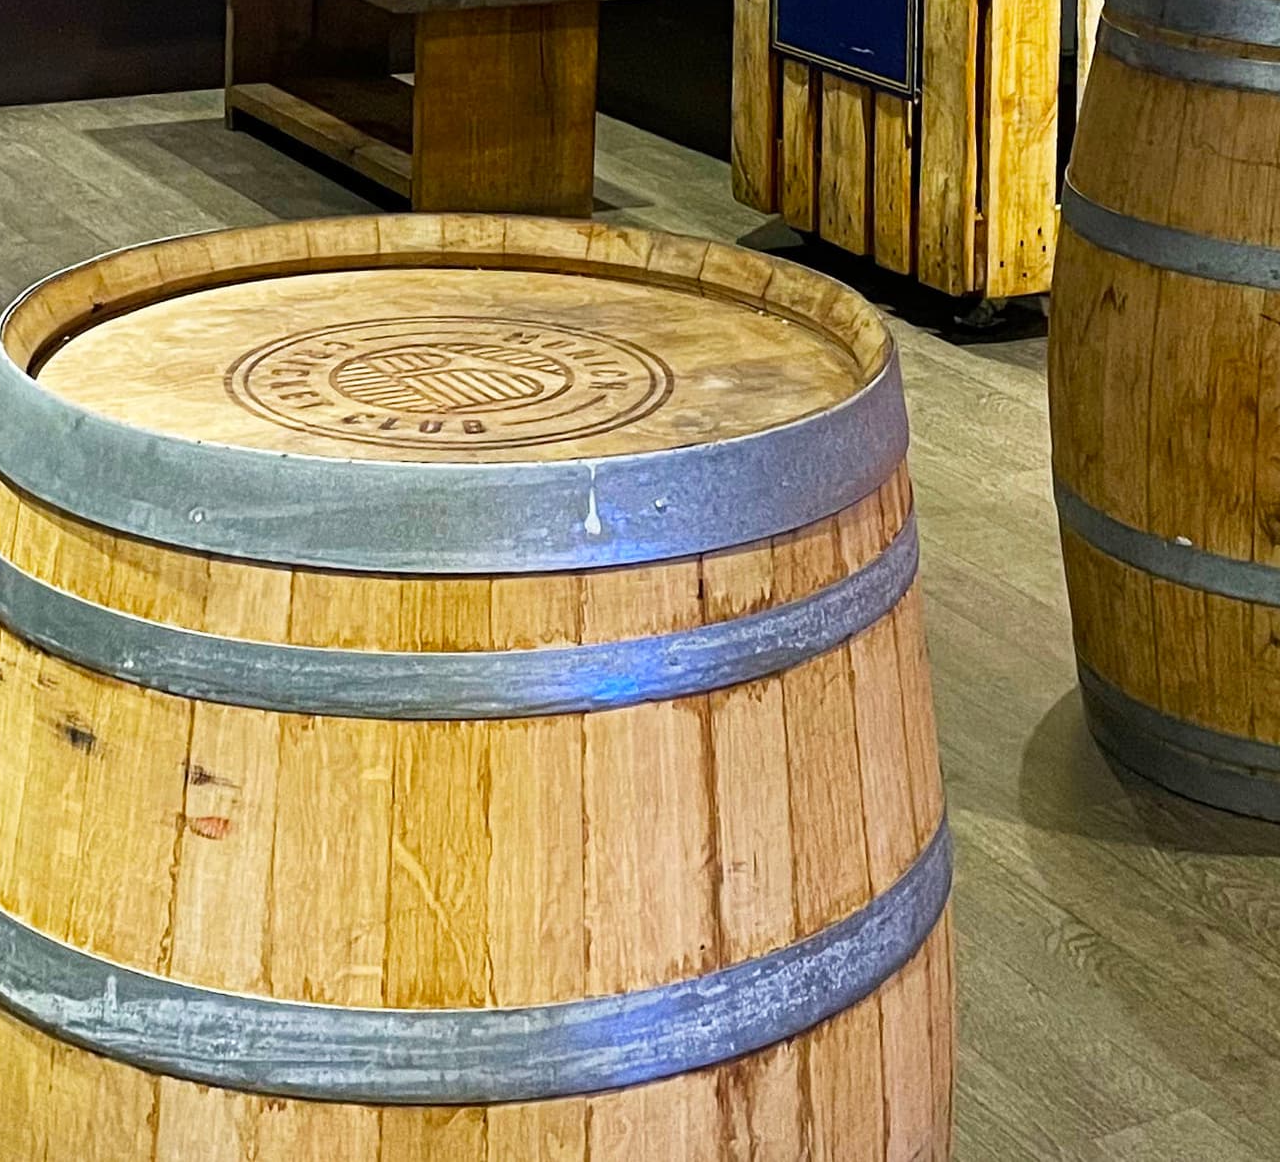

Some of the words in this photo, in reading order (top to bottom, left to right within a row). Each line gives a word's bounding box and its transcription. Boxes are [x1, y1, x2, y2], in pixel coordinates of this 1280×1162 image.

[269, 340, 355, 409] CRICKET
[502, 331, 629, 391] MUNICH
[341, 412, 488, 435] CLUB
